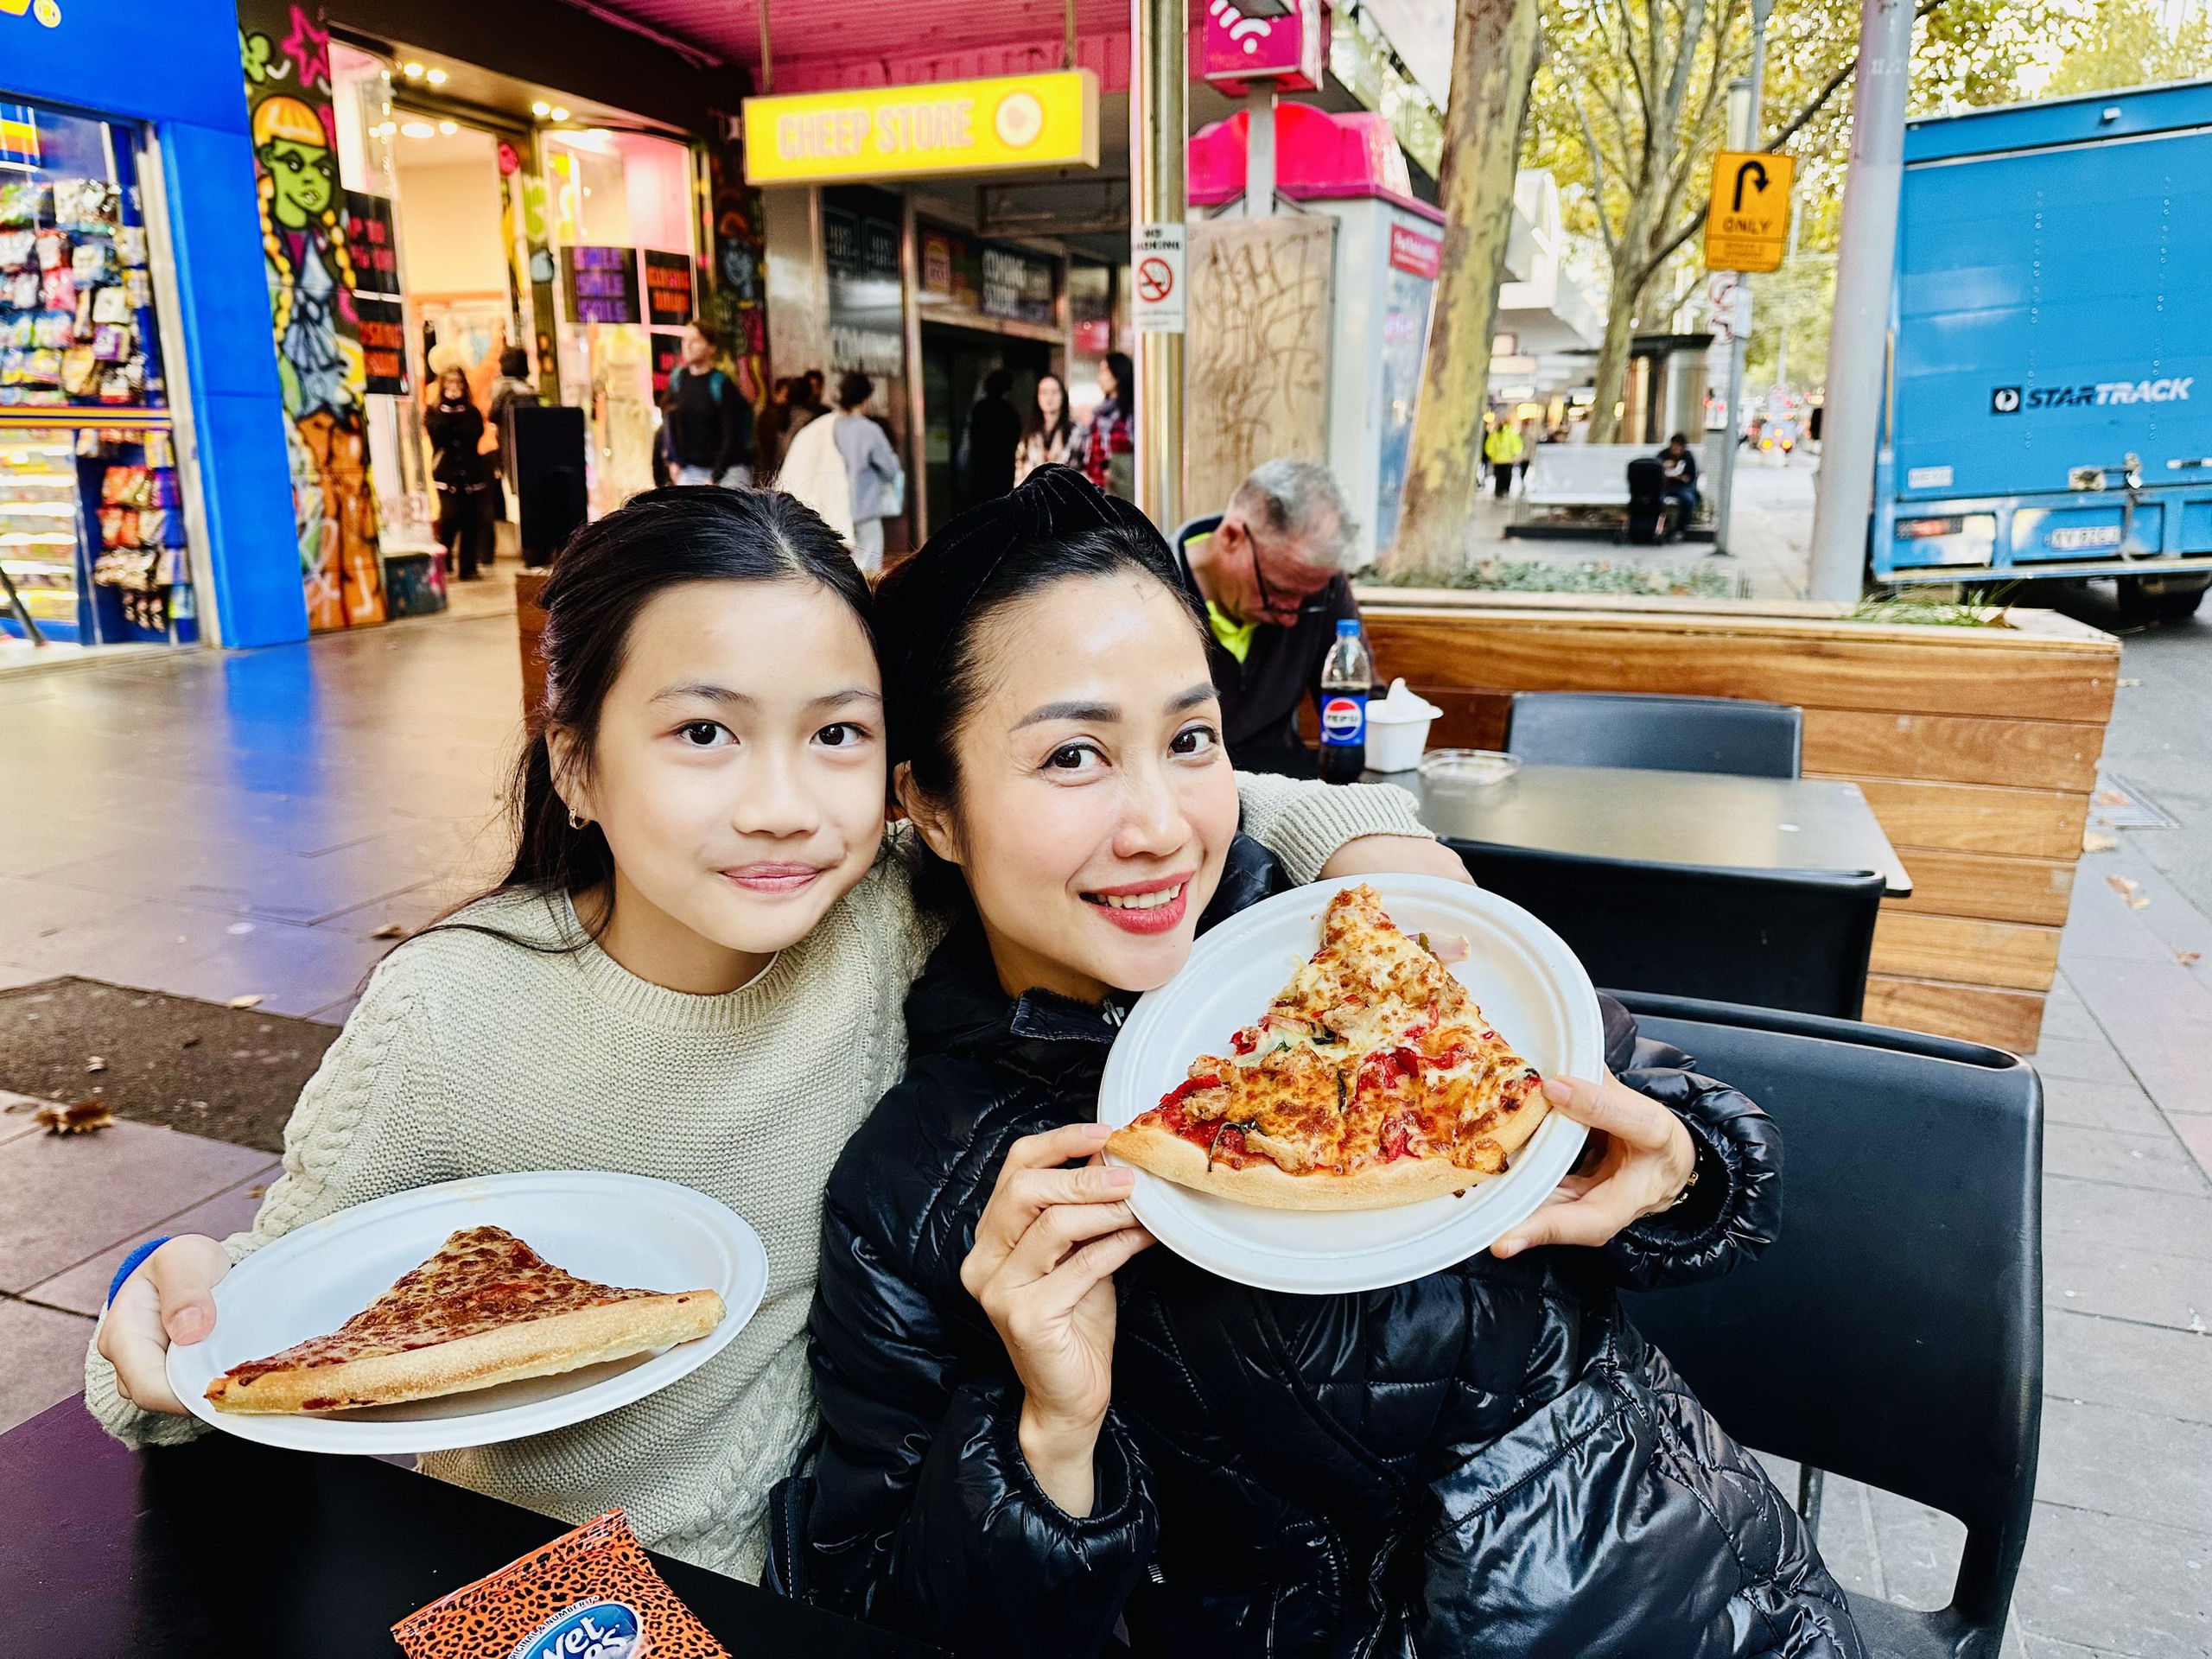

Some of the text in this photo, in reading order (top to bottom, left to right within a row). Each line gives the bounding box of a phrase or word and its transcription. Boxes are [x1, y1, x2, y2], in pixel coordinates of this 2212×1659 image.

[778, 108, 870, 161] CHEEP
[876, 99, 974, 153] STORE
[1722, 218, 1771, 235] ONLY
[2025, 377, 2195, 409] STARTRACK
[508, 1630, 541, 1659] RIGINAL
[545, 1601, 586, 1626] NUMBER
